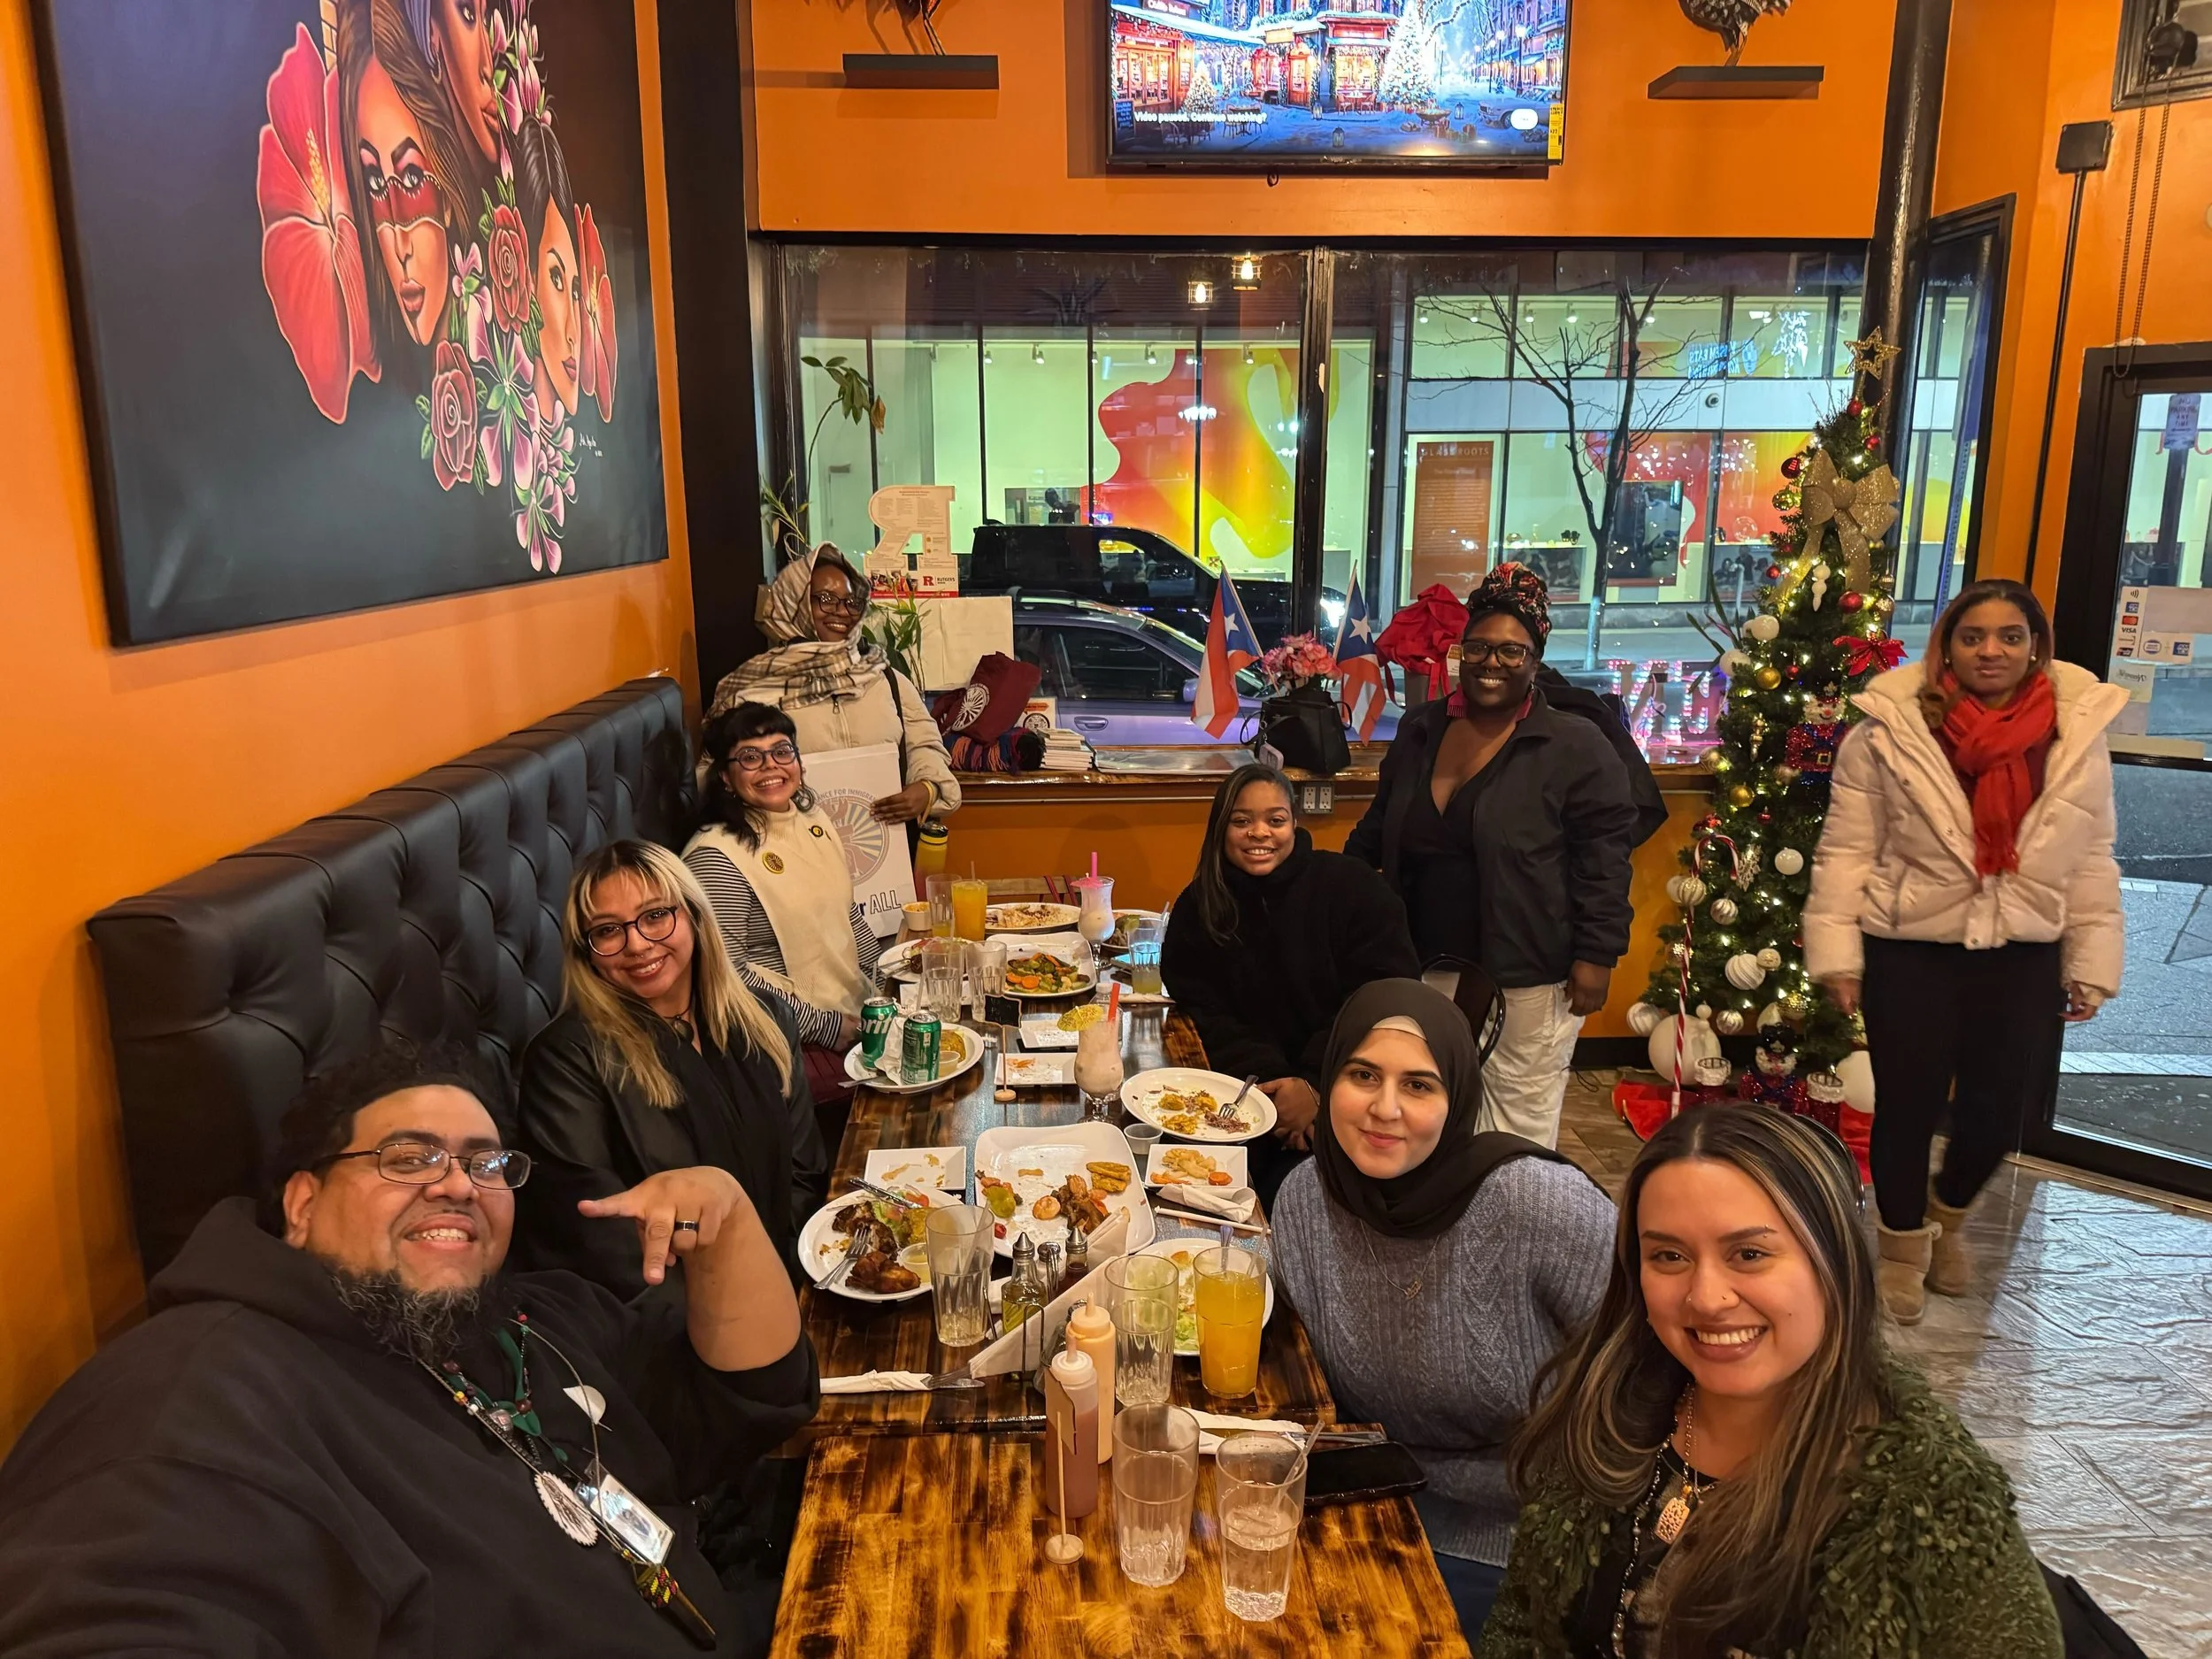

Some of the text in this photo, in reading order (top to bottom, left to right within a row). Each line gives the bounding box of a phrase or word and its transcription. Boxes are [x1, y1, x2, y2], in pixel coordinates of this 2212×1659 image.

[1134, 111, 1157, 122] Video
[1159, 112, 1189, 124] paused.
[1191, 111, 1226, 122] Continue
[1227, 111, 1267, 125] watching?
[923, 576, 934, 586] R
[871, 889, 902, 915] ALL
